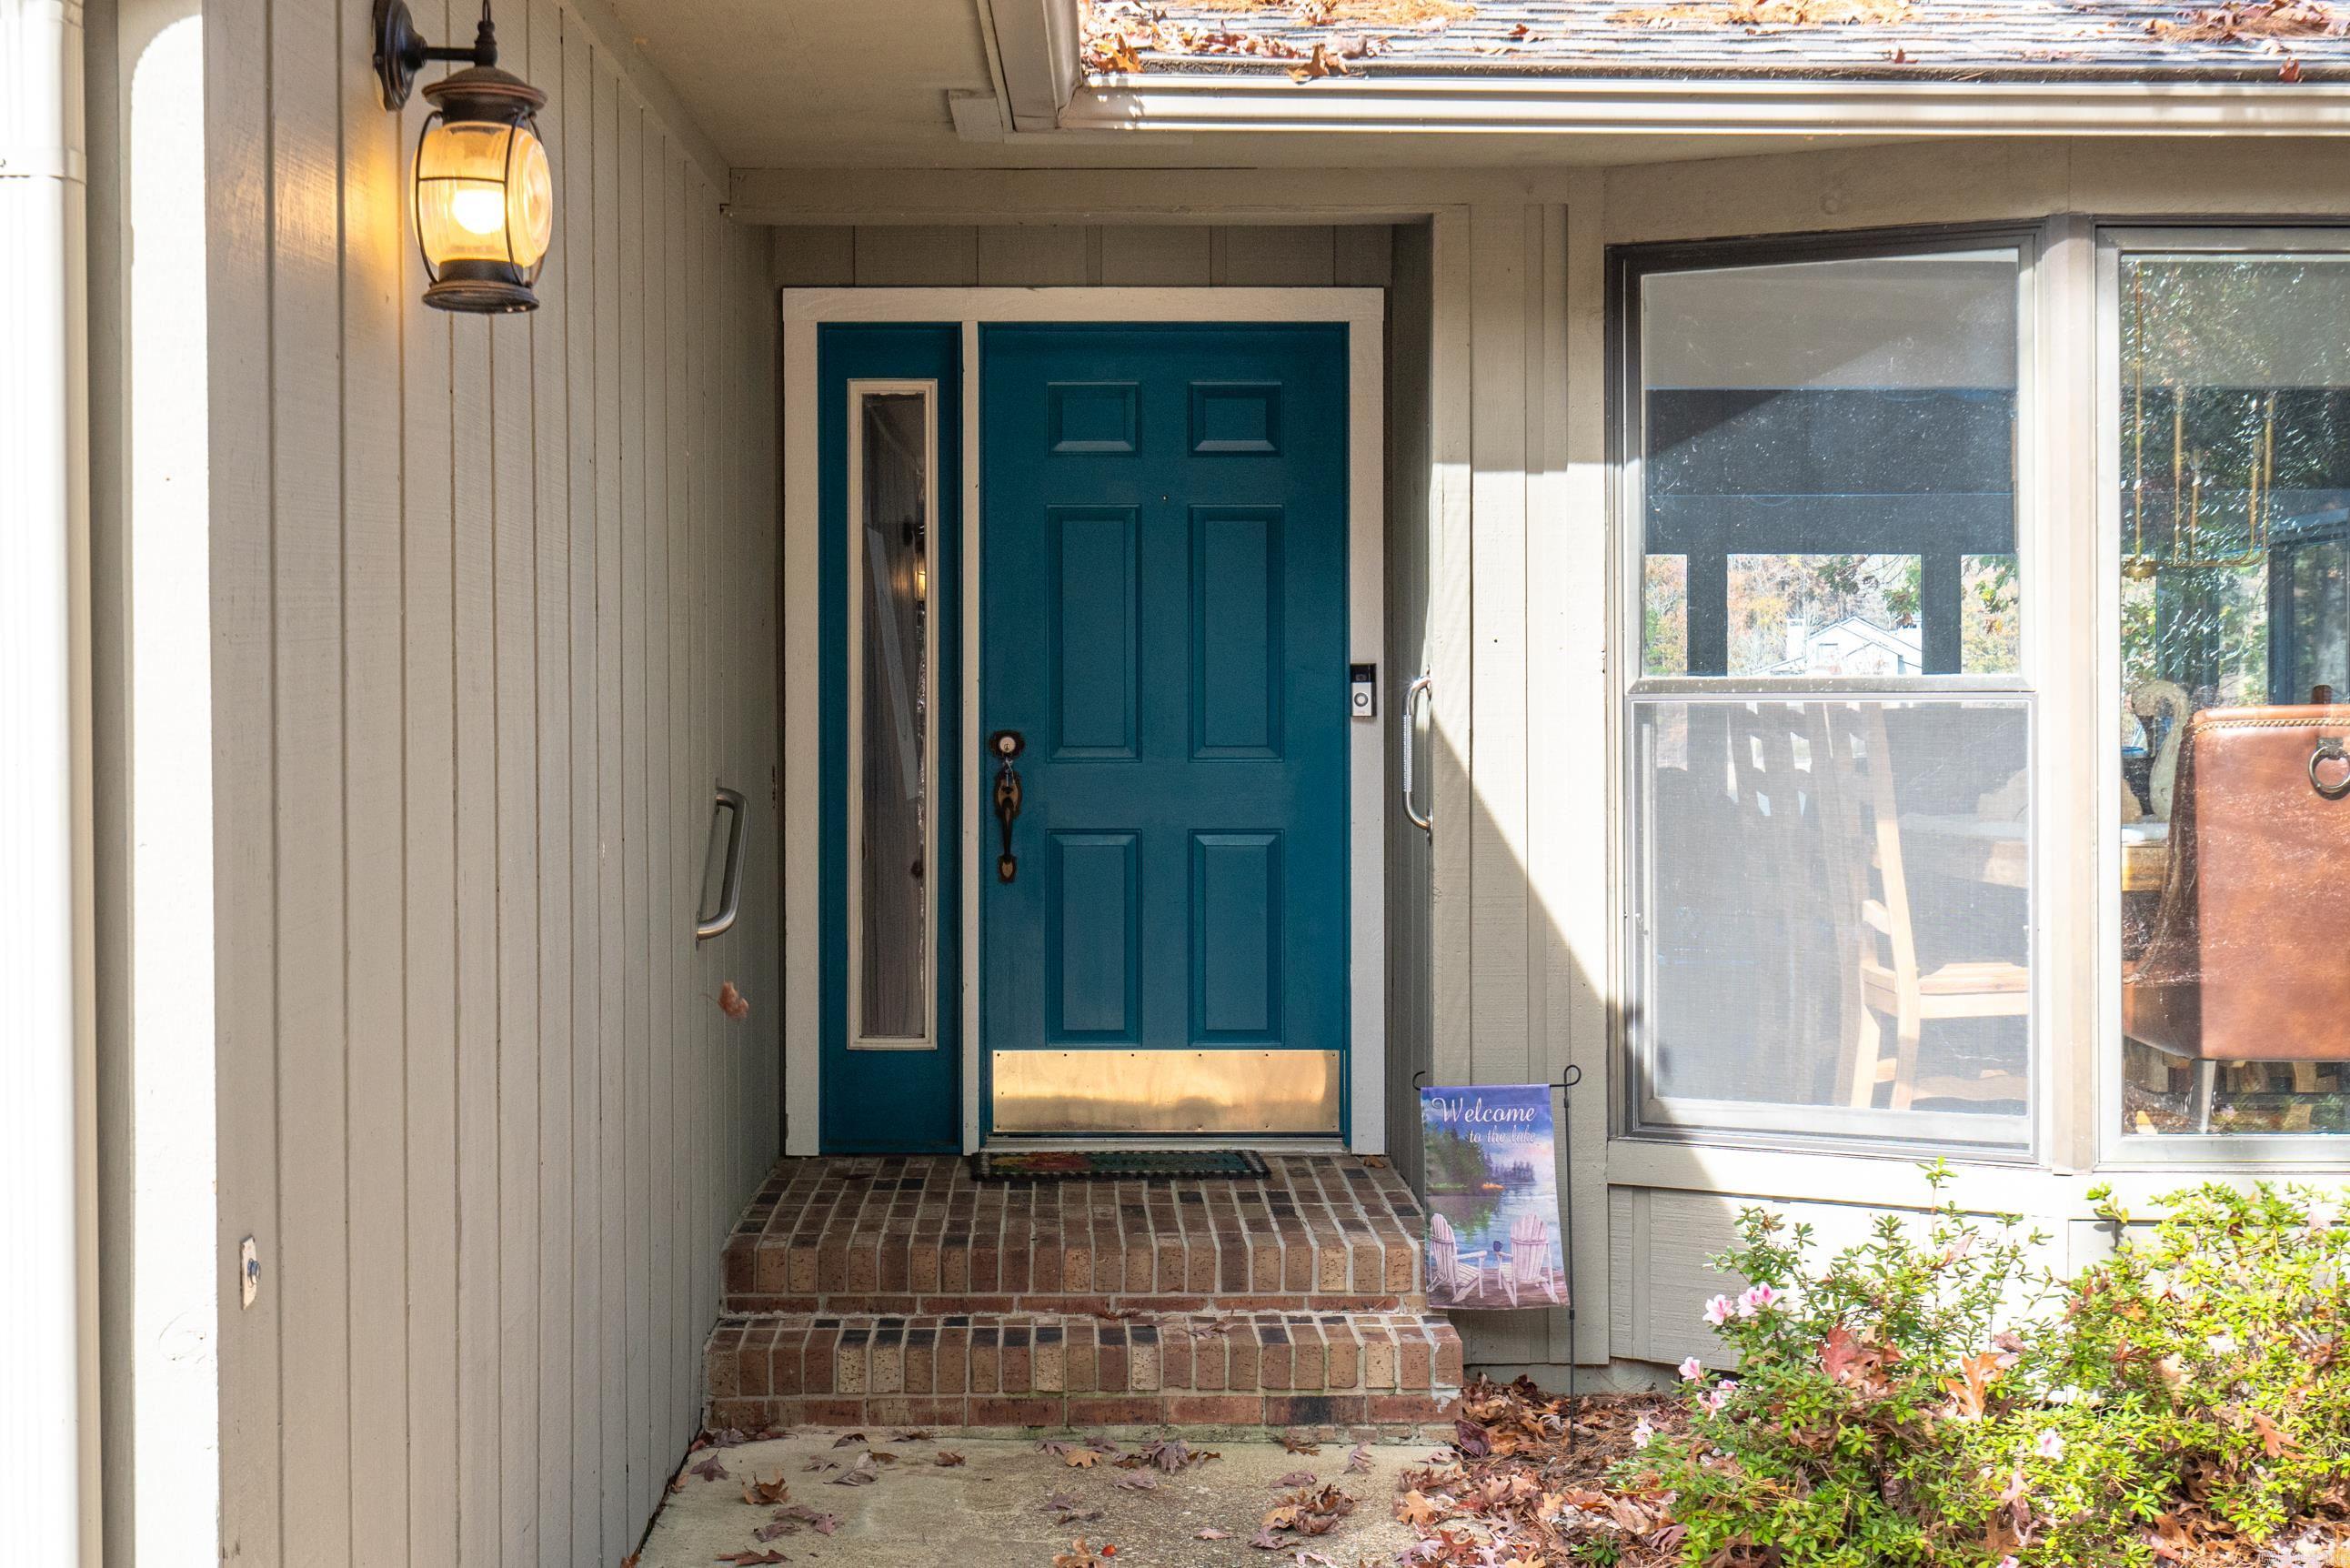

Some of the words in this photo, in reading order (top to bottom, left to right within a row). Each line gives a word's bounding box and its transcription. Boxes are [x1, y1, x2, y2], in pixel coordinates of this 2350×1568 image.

[1431, 1097, 1536, 1122] Welcome
[1470, 1129, 1481, 1143] to
[1487, 1125, 1506, 1143] the
[1510, 1124, 1536, 1143] lake
